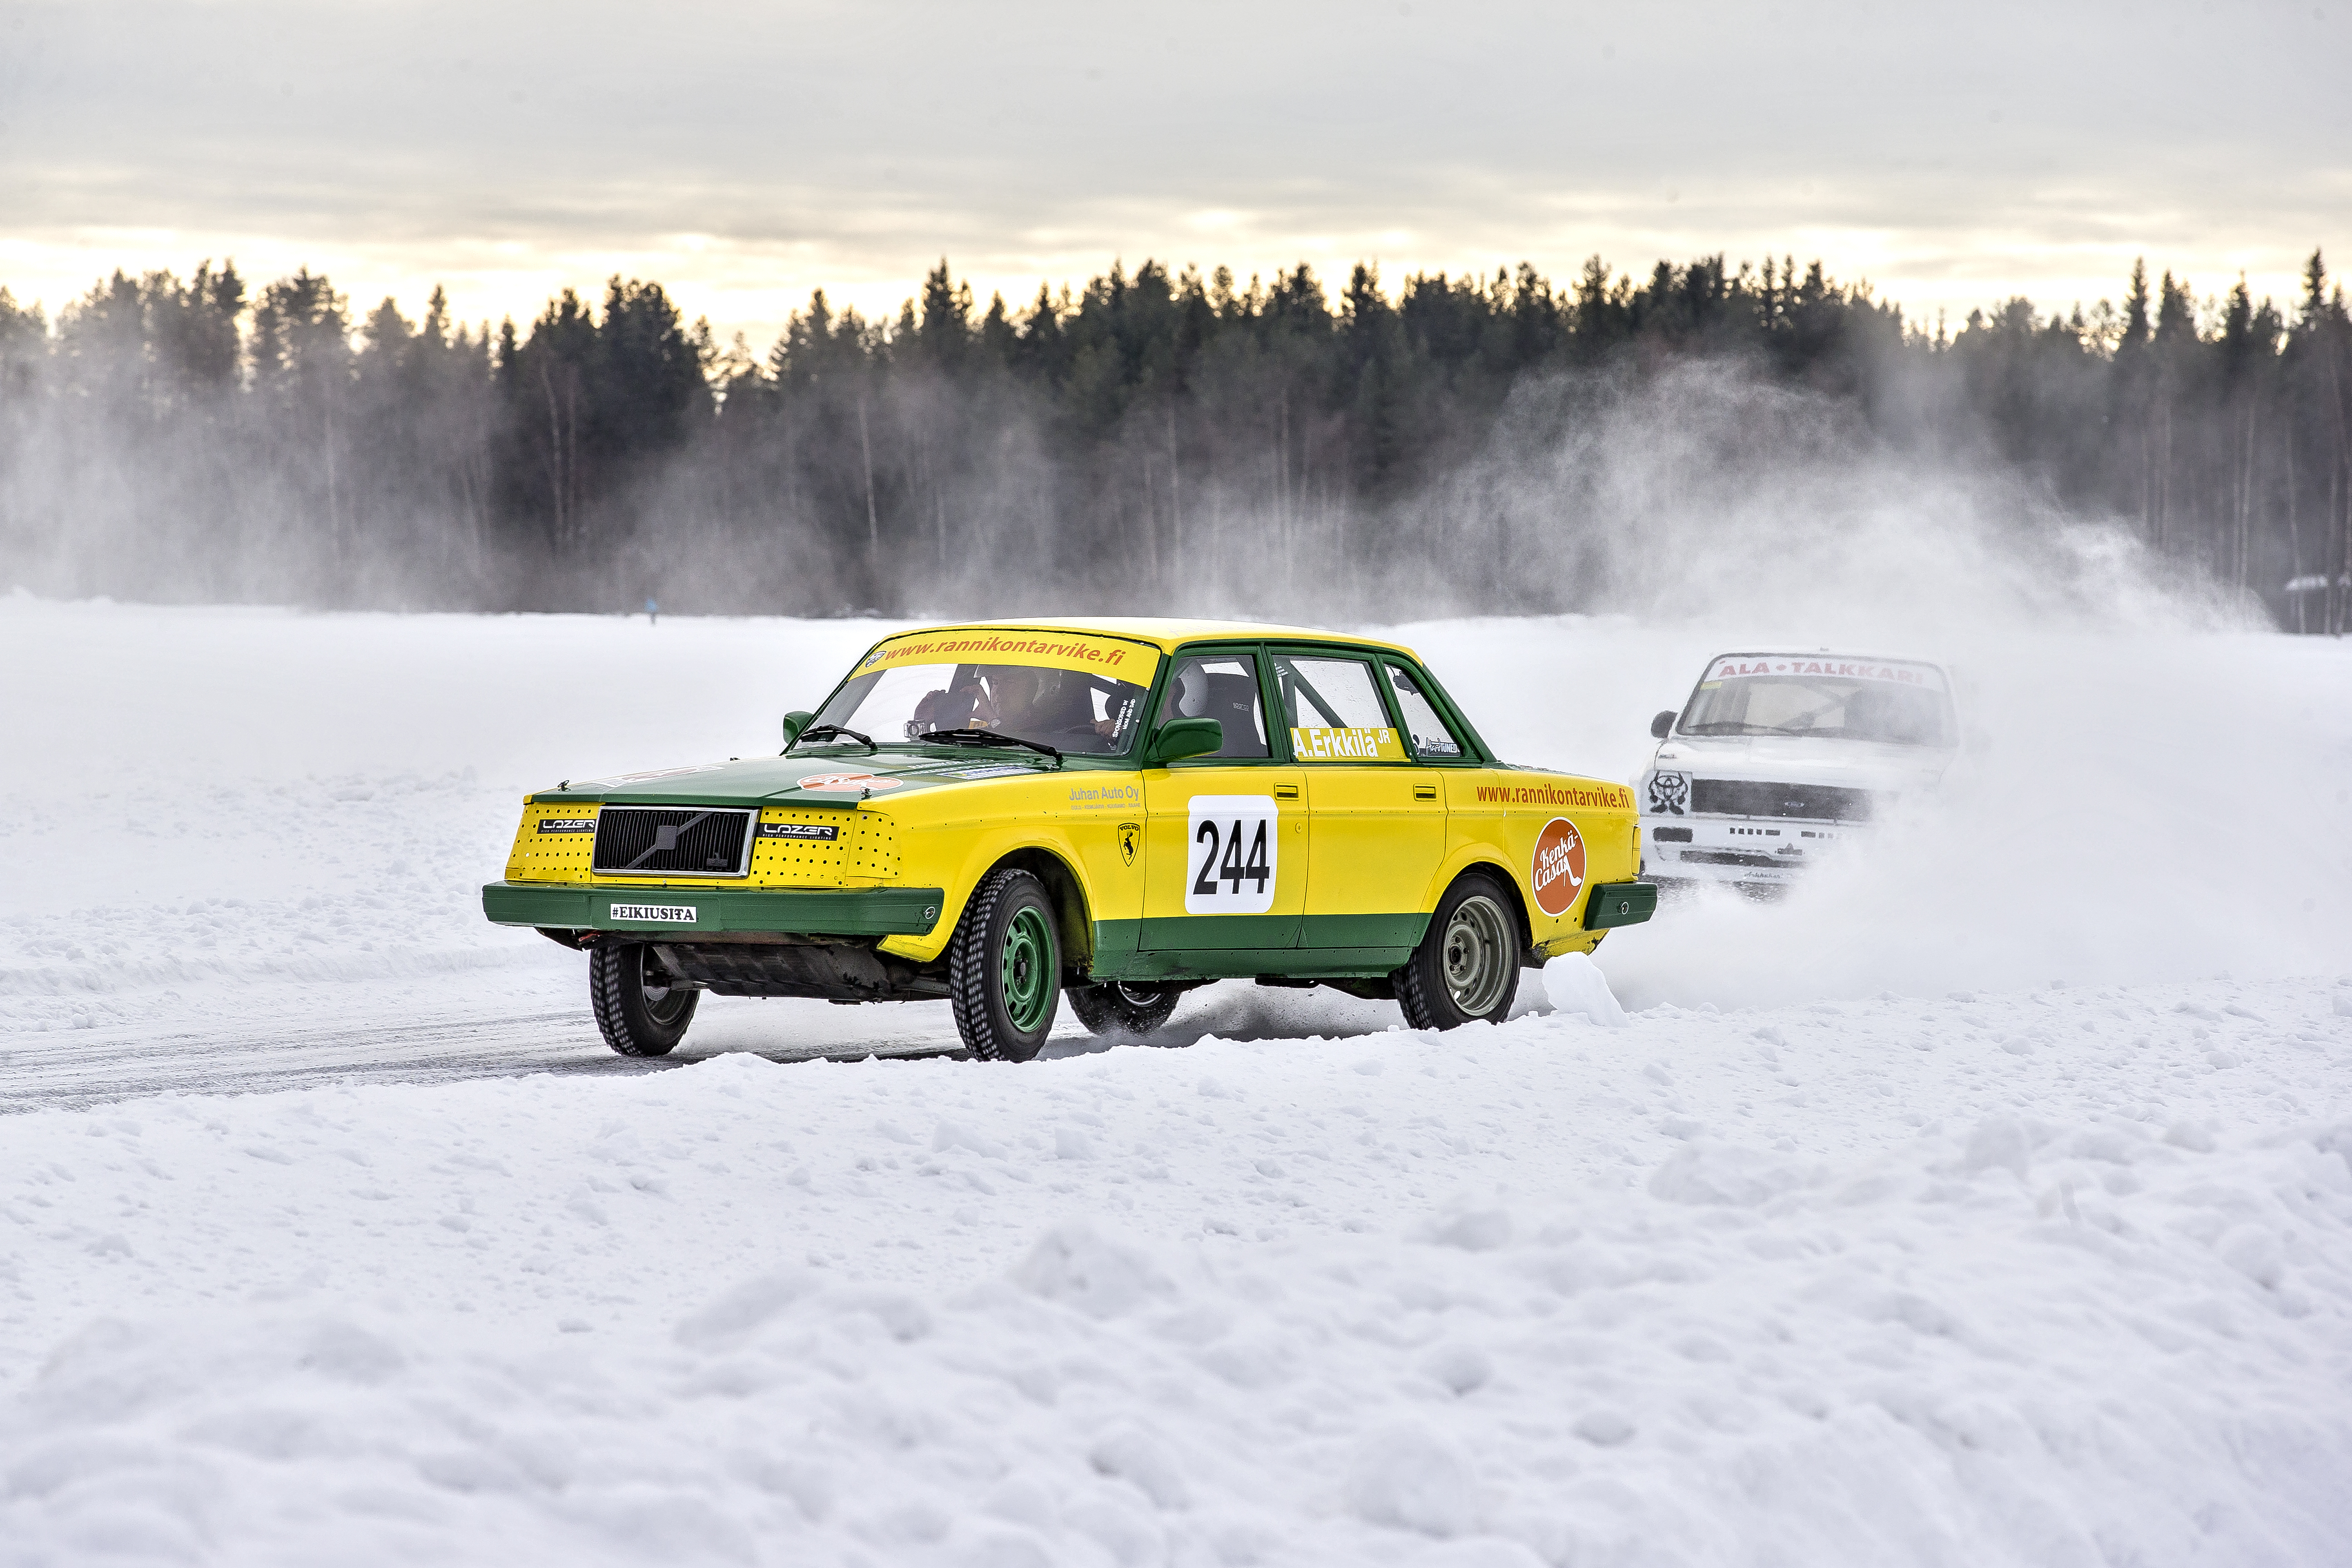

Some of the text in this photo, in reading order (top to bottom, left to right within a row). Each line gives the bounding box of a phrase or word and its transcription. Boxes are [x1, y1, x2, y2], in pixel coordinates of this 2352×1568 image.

[885, 637, 1126, 666] www.rannikontarvike.fi
[1112, 706, 1127, 738] SPONSORED
[1293, 728, 1391, 757] A.Erkkilä JR
[1069, 785, 1139, 801] Juhan Auto Oy
[1476, 783, 1630, 808] www.rannikontarvike.fi
[543, 820, 595, 828] LAZER
[764, 824, 833, 835] LAZER
[1193, 819, 1270, 895] 244
[612, 906, 695, 921] #EIKIUSITA
